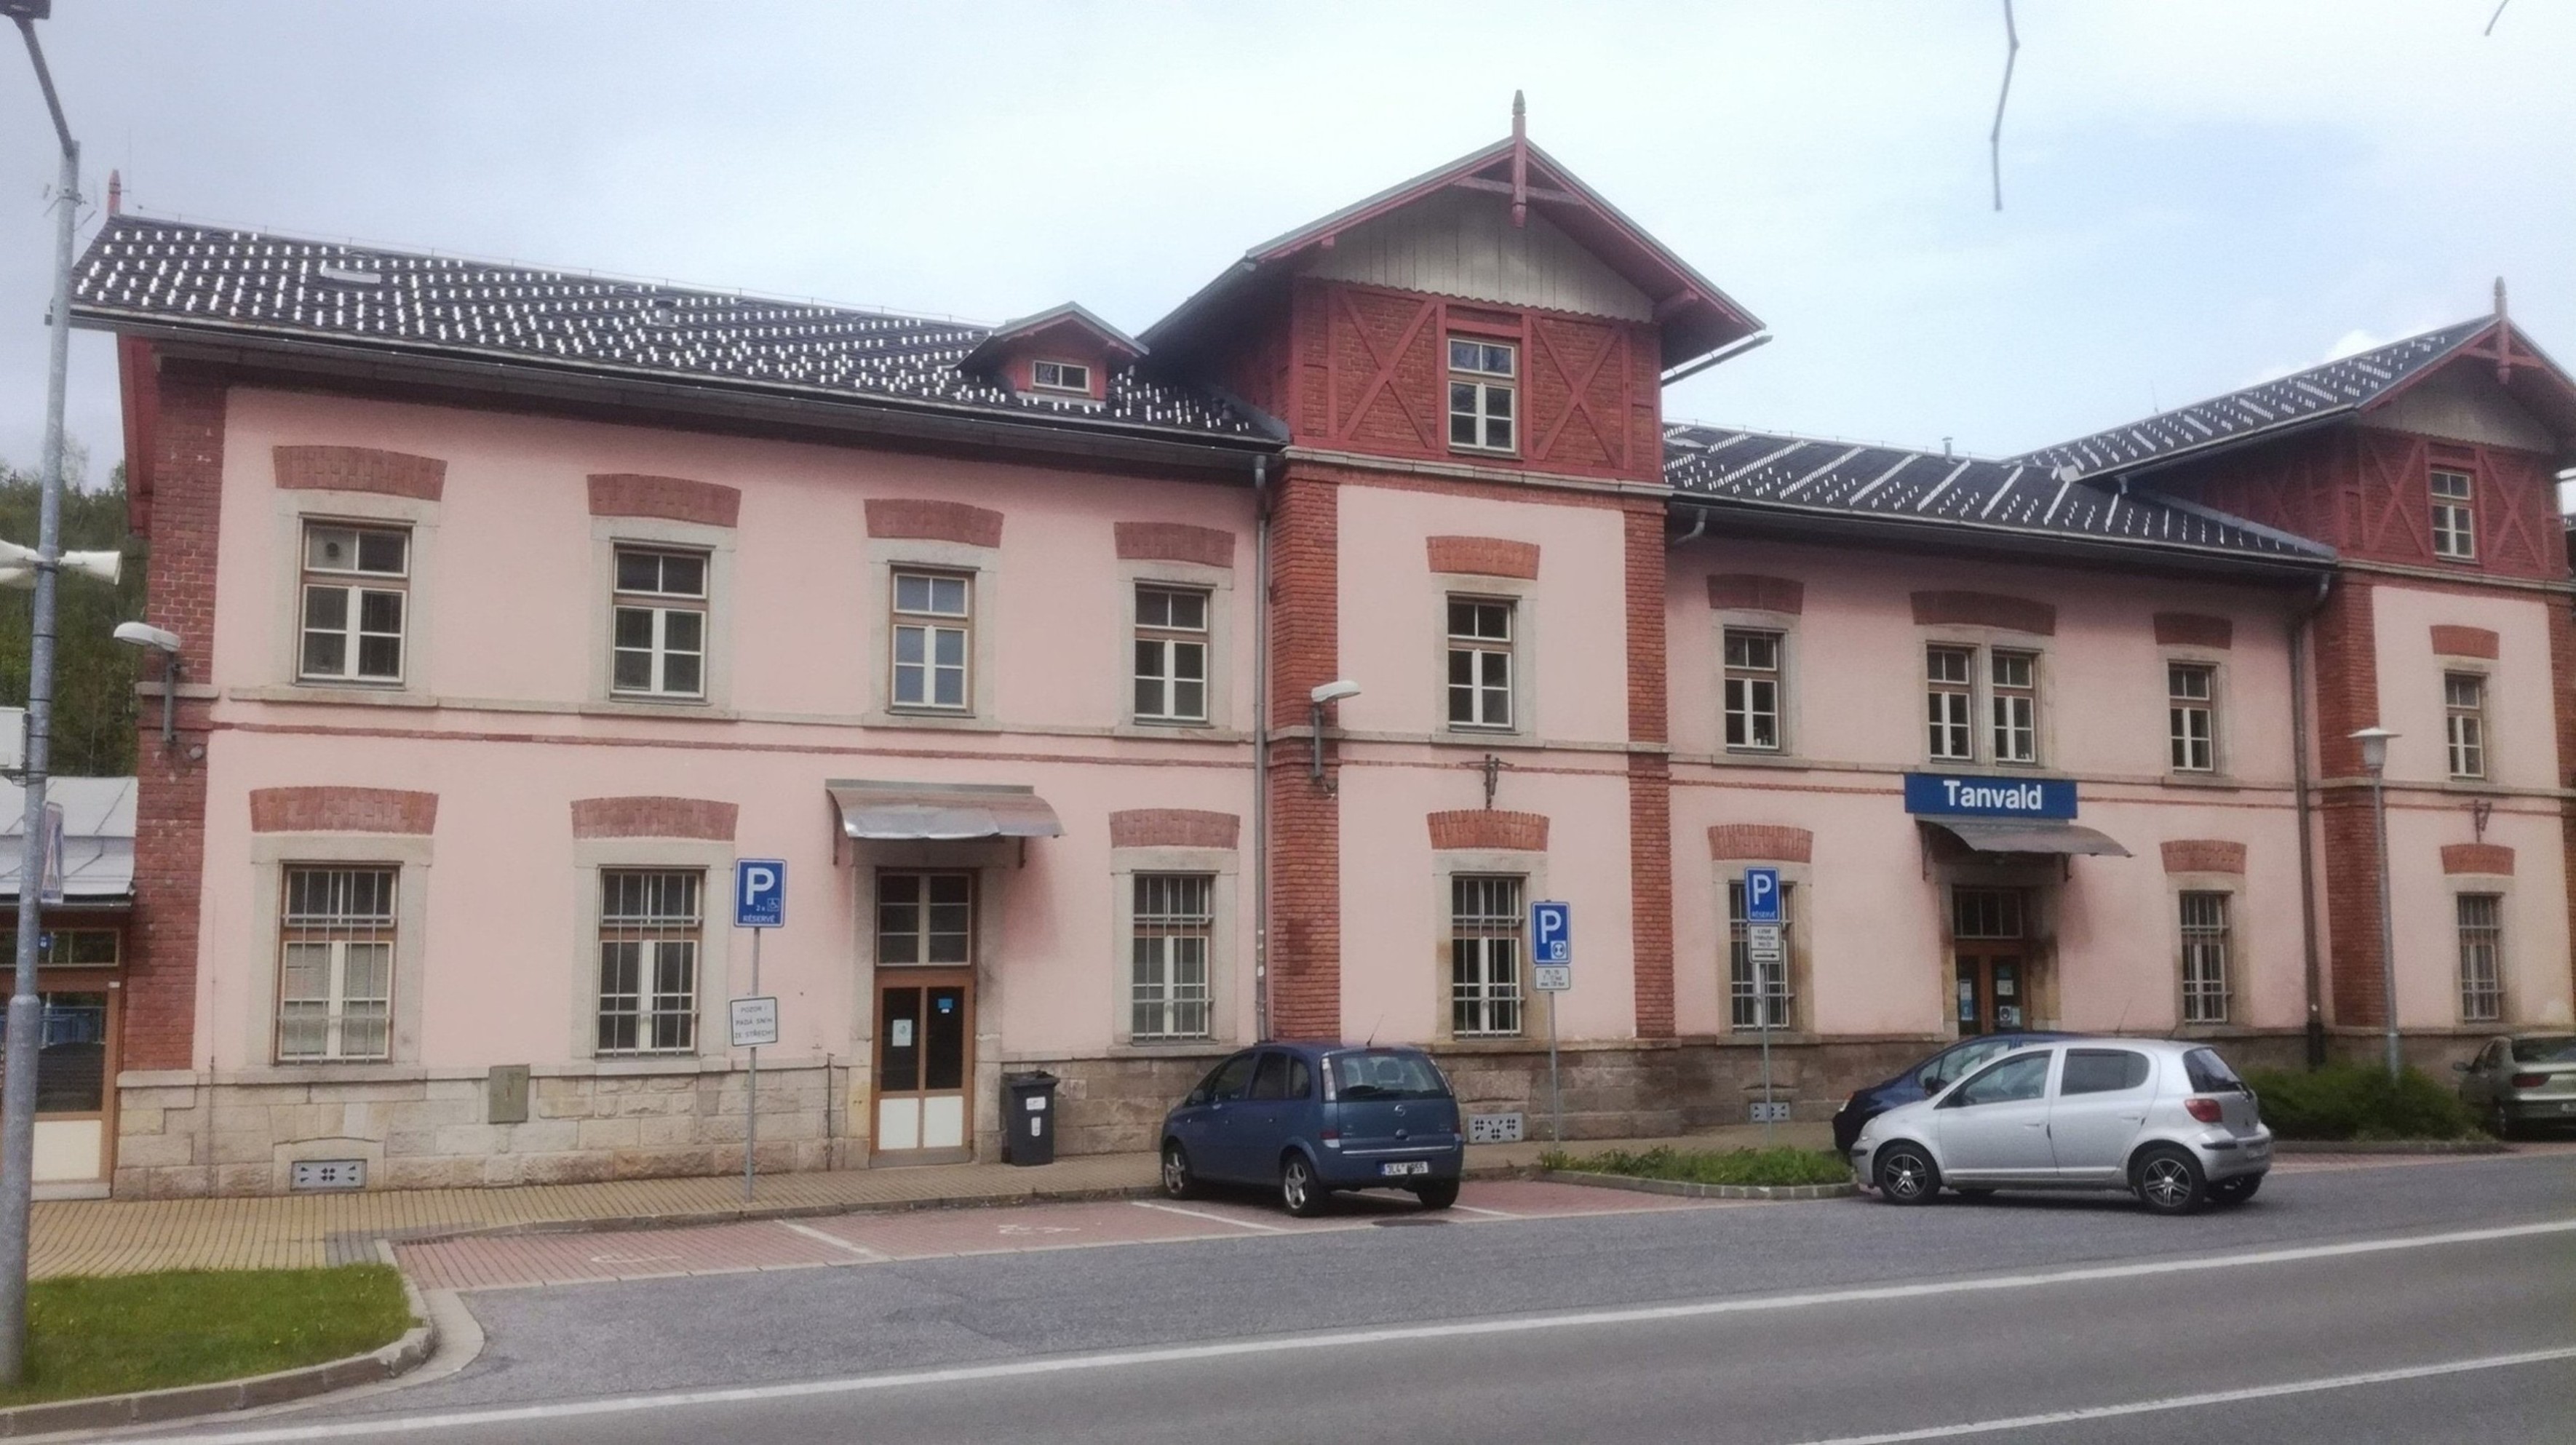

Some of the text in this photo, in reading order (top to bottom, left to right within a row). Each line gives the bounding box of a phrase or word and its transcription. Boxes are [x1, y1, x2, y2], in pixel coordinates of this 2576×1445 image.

[1943, 779, 2043, 810] Tanvald
[746, 867, 775, 905] P
[1752, 874, 1772, 905] P
[1541, 909, 1562, 944] P
